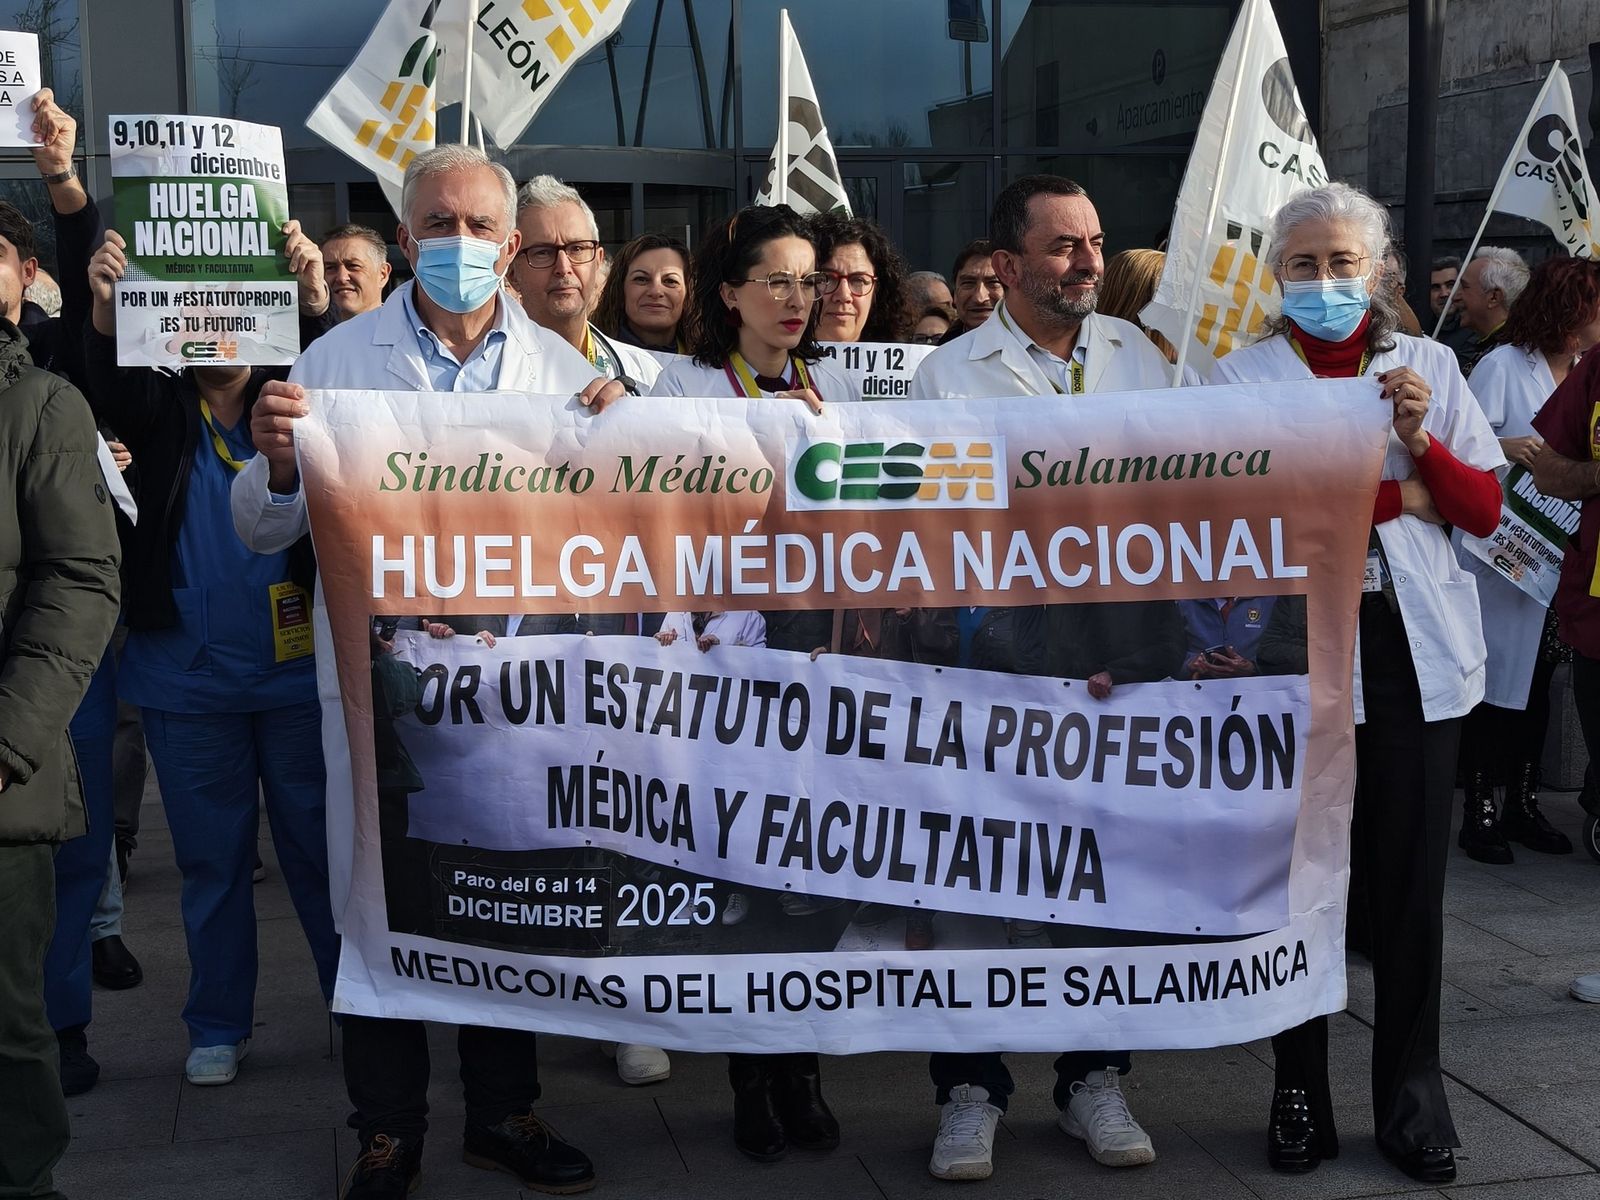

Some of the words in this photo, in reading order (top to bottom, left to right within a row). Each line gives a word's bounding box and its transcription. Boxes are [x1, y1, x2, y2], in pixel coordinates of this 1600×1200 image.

[477, 1, 550, 92] LEÓN
[13, 71, 24, 83] A
[1117, 88, 1205, 136] Aparcamiento
[114, 120, 186, 149] 9,10,11
[192, 125, 204, 149] y
[212, 123, 235, 148] 12
[191, 153, 280, 179] diciembre
[1258, 141, 1329, 188] CAS
[150, 183, 259, 218] HUELGA
[134, 221, 276, 256] NACIONAL
[165, 262, 196, 274] MÉDICA
[198, 264, 203, 273] Y
[205, 263, 254, 274] FACULTATIVA
[121, 292, 147, 307] POR
[151, 292, 169, 307] UN
[173, 291, 292, 307] #ESTATUTOPROPIO
[160, 317, 180, 333] ¡ES
[183, 317, 200, 332] TU
[204, 316, 256, 332] FUTURO!
[181, 341, 238, 358] CESM
[866, 350, 877, 372] y
[884, 348, 904, 370] 12
[862, 376, 911, 395] dicie
[380, 451, 595, 494] Sindicato
[608, 453, 773, 494] Médico
[794, 442, 995, 500] CESM
[1015, 446, 1272, 490] Salamanca
[372, 535, 658, 598] HUELGA
[675, 519, 935, 596] MÉDICA
[952, 517, 1308, 592] NACIONAL
[1505, 540, 1515, 553] TU
[1514, 548, 1541, 574] FUTURO!
[413, 663, 484, 725] OR
[500, 659, 565, 724] UN
[585, 660, 811, 751] ESTATUTO
[825, 686, 891, 760] DE
[904, 696, 968, 770] LA
[984, 695, 1295, 791] PROFESIÓN
[547, 750, 696, 852] MÉDICA
[714, 788, 748, 859] Y
[756, 794, 1106, 904] FACULTATIVA
[454, 870, 496, 891] Paro
[501, 876, 529, 893] del
[535, 876, 547, 893] 6
[553, 877, 569, 893] al
[575, 878, 597, 894] 14
[448, 895, 603, 929] DICIEMBRE
[616, 882, 716, 927] 2025
[643, 974, 733, 1014] DEL
[747, 968, 972, 1013] HOSPITAL
[987, 966, 1047, 1007] DE
[1062, 939, 1309, 1007] SALAMANCA
